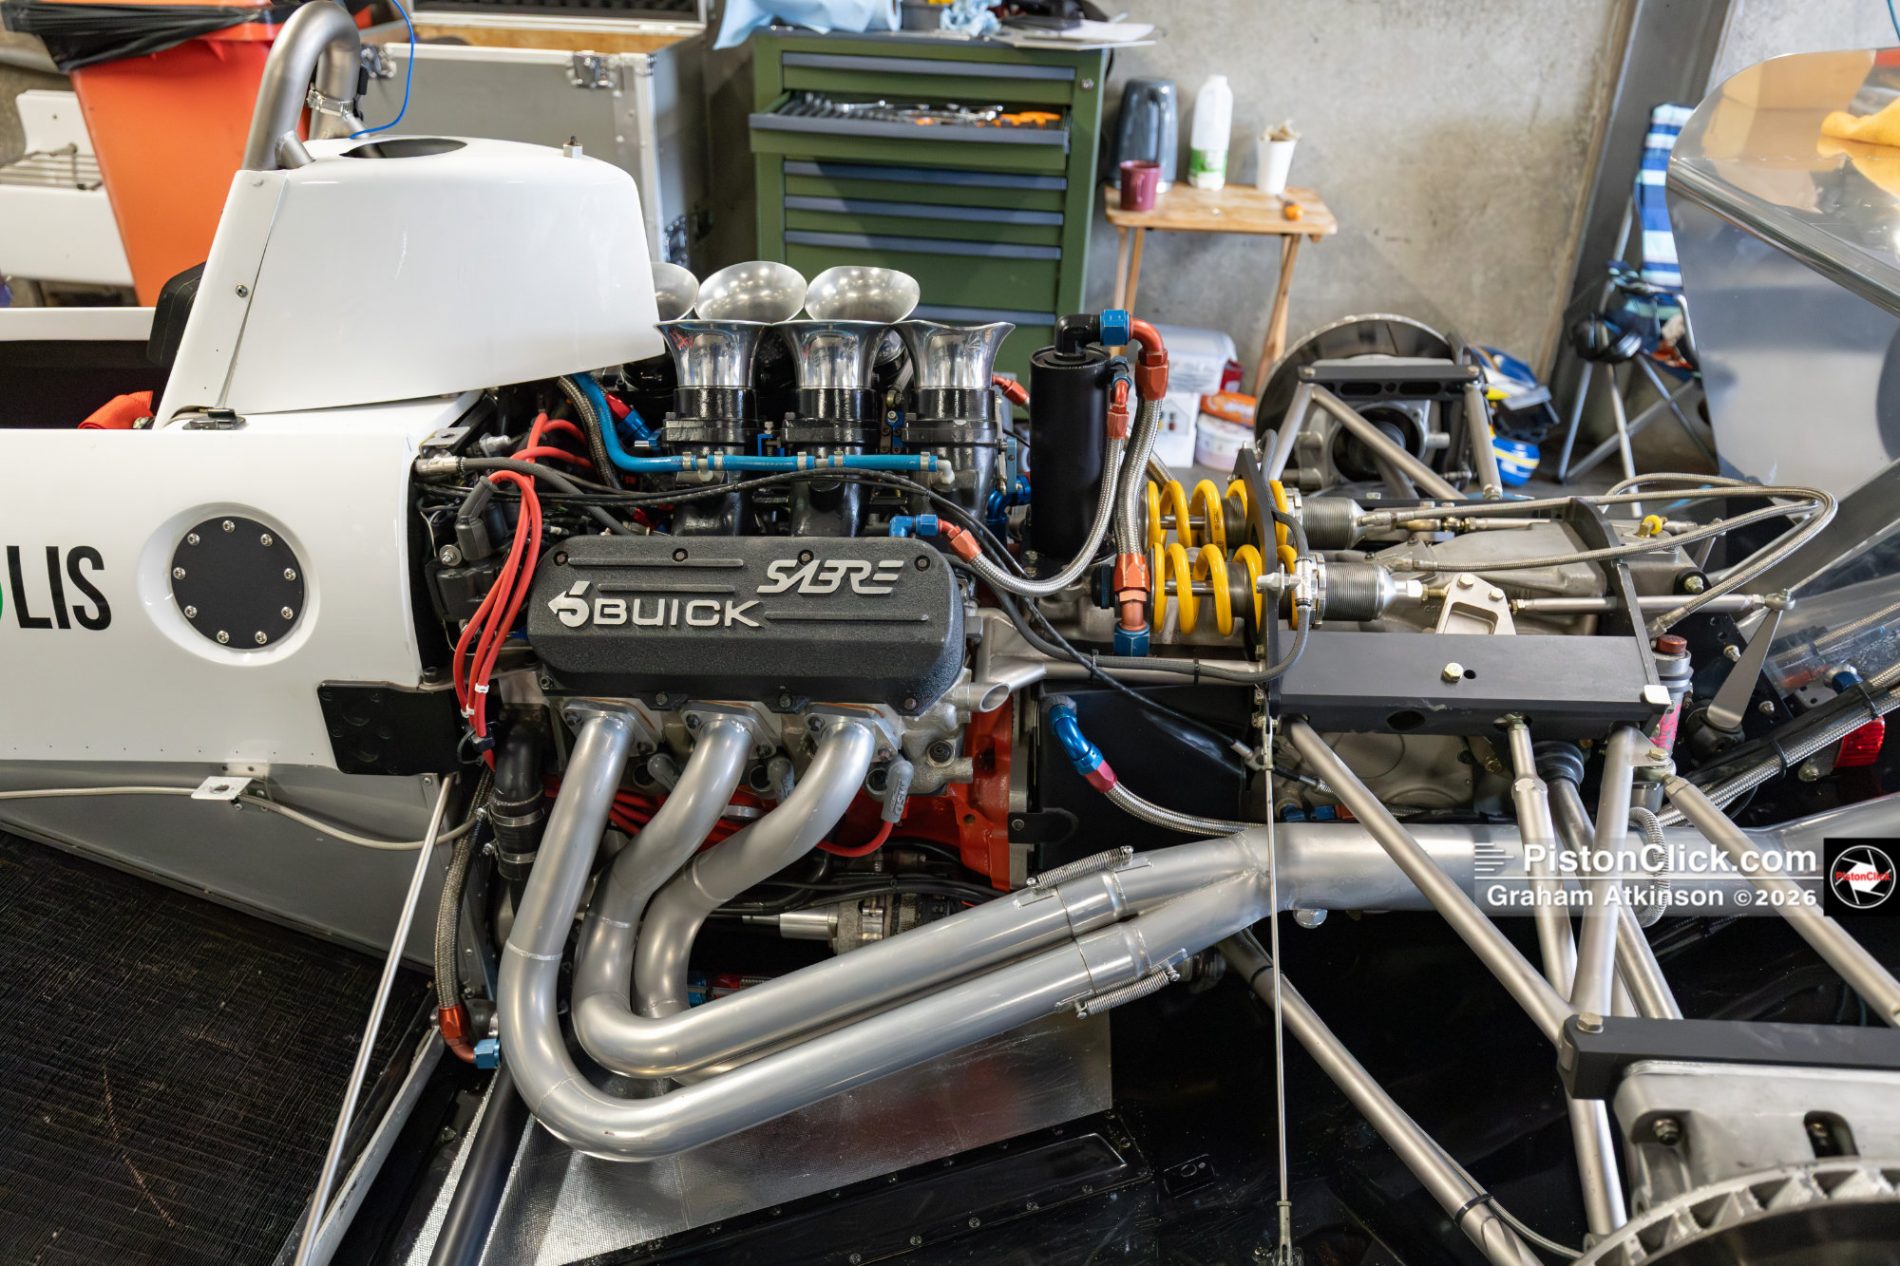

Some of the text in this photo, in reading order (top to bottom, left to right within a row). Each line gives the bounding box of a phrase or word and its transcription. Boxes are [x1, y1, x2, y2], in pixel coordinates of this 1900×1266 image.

[0, 545, 112, 631] LIS
[756, 559, 904, 595] SABRE
[593, 598, 762, 628] BUICK
